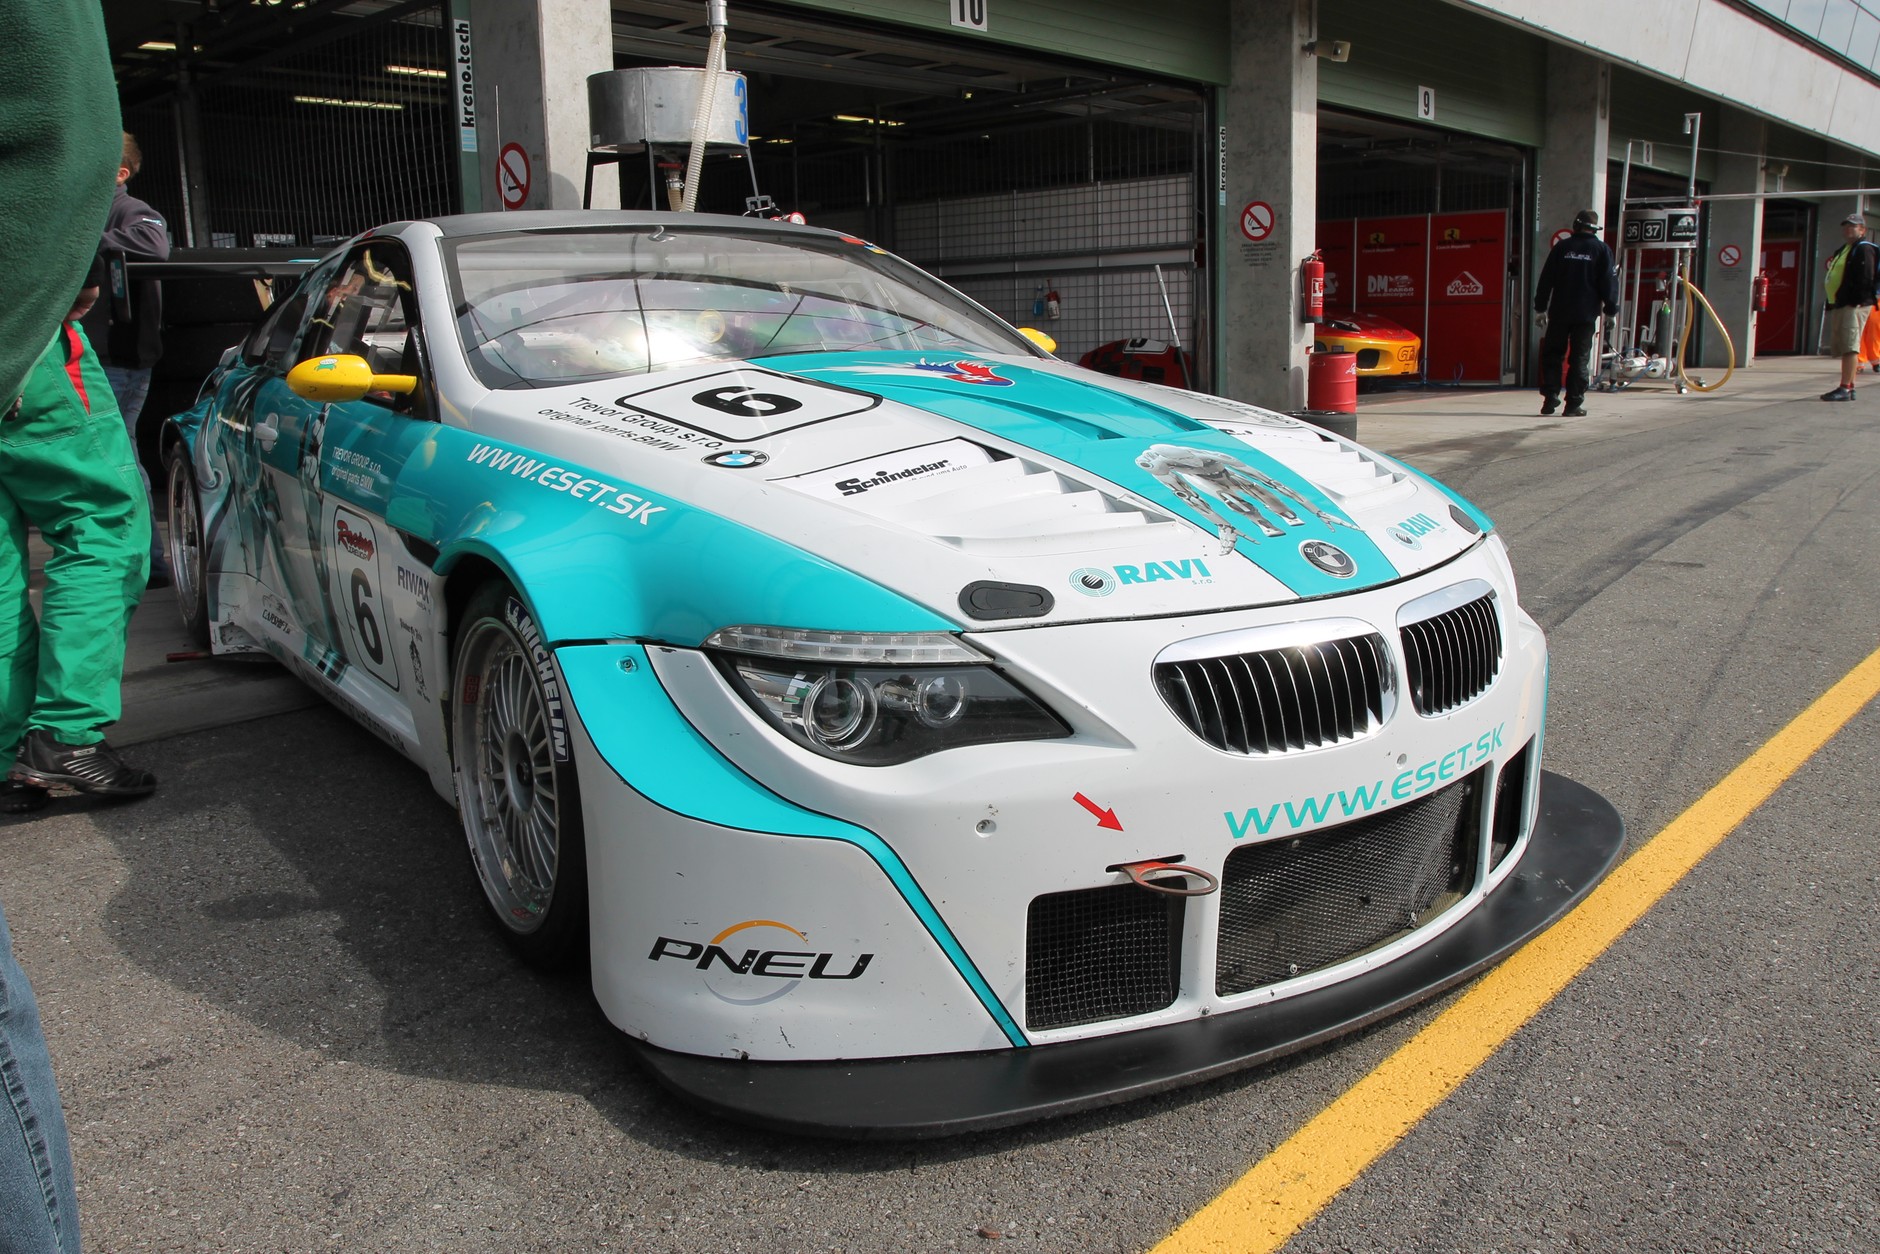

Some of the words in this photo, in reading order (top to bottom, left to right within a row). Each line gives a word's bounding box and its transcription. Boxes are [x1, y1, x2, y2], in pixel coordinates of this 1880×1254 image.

[456, 22, 475, 128] kreno.tech
[734, 76, 749, 145] 3
[1423, 90, 1430, 116] 9
[1645, 224, 1660, 237] 37
[1368, 275, 1388, 293] DM
[1449, 280, 1480, 294] Roto
[691, 385, 801, 417] 6
[538, 408, 598, 431] original
[591, 420, 638, 440] parts
[632, 434, 687, 452] BMW
[568, 397, 623, 418] Trevor
[622, 413, 679, 437] Group,
[678, 430, 723, 450] s.r.o.
[332, 446, 352, 463] TREVOR
[350, 450, 371, 468] GROUP
[952, 464, 968, 472] Auto
[1397, 512, 1441, 537] RAVI
[397, 565, 430, 604] RIWAX
[1112, 558, 1212, 585] RAVI
[350, 567, 384, 665] 6
[517, 614, 567, 758] MICHELIN
[647, 936, 875, 980] PNEU
